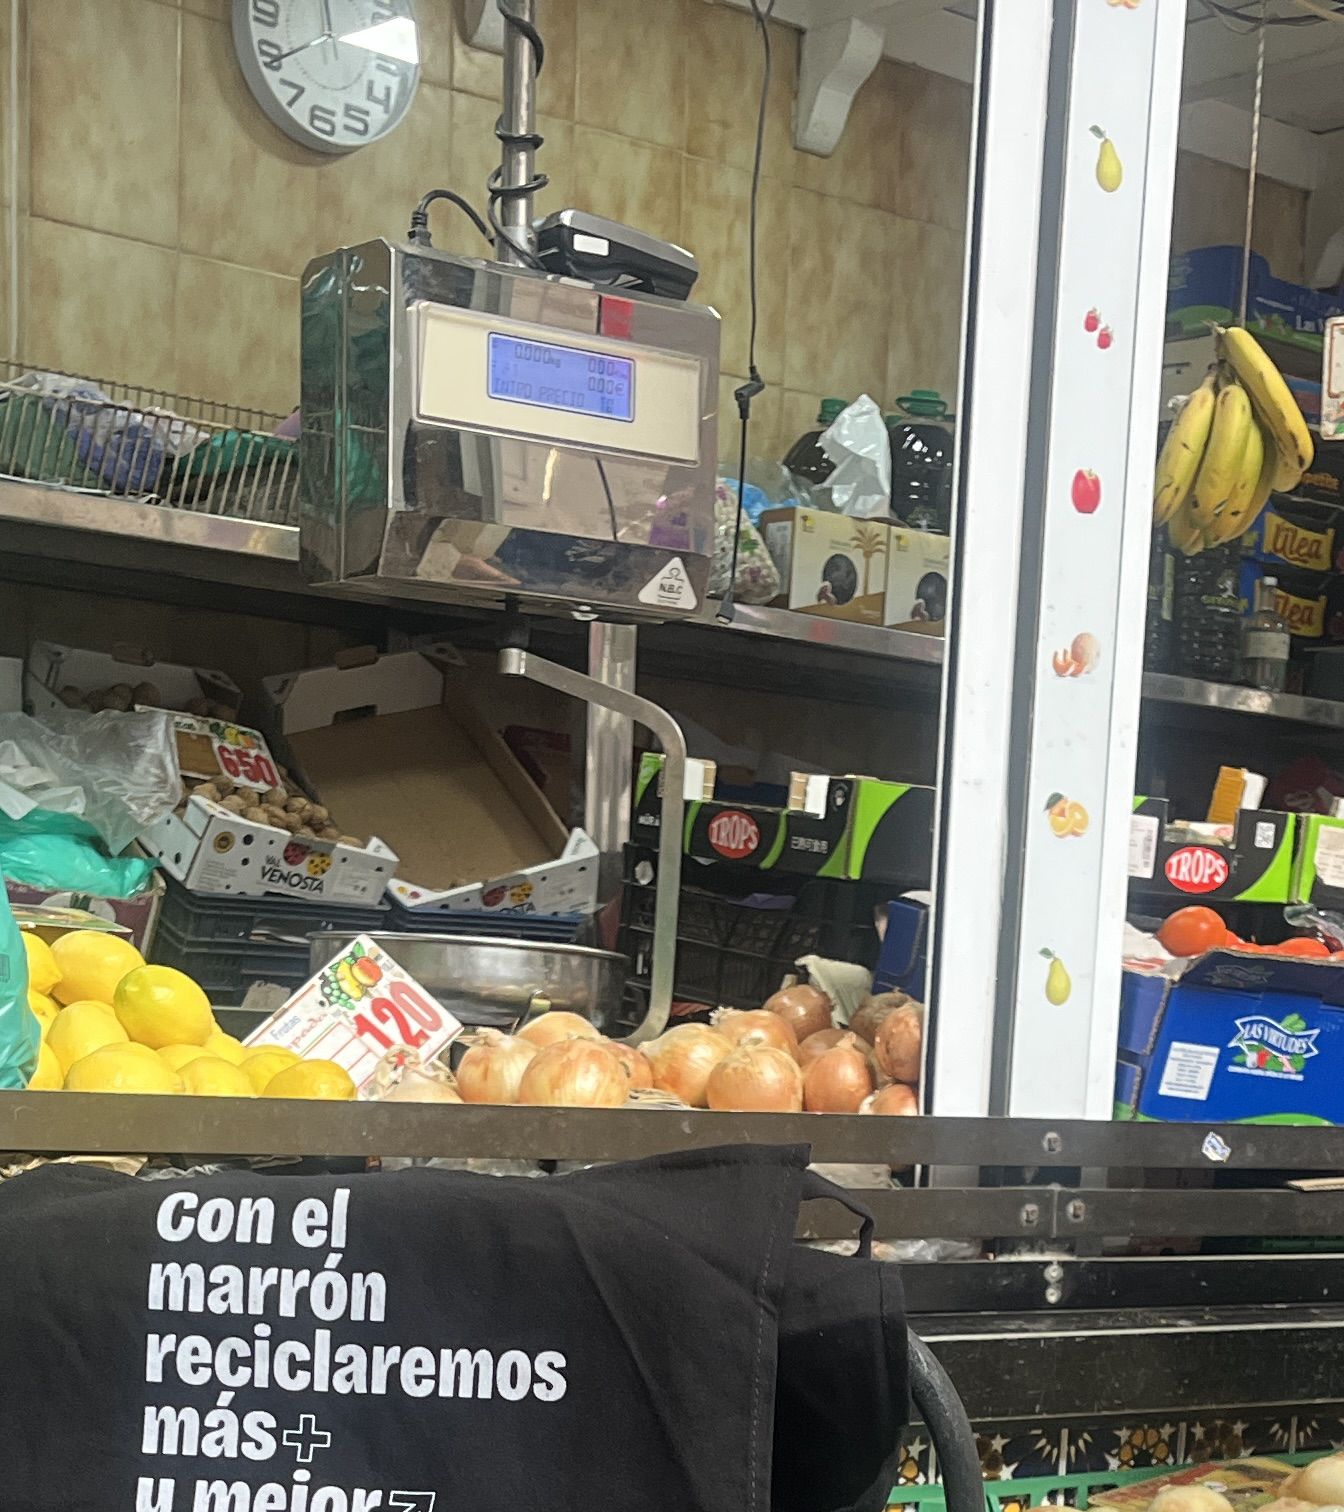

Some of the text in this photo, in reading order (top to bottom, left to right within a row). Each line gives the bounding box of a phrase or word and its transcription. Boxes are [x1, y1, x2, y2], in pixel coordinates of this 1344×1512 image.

[279, 77, 306, 109] 7
[367, 79, 392, 115] 4
[309, 104, 337, 138] 6
[343, 103, 370, 137] 5
[709, 815, 759, 851] TROPS
[260, 865, 326, 894] VENOSTA
[1166, 850, 1227, 885] TROPS
[352, 980, 443, 1051] 120
[1242, 1022, 1308, 1055] LAS VIRTUDES
[156, 1187, 351, 1249] Con el
[147, 1252, 387, 1323] marrón
[144, 1322, 568, 1402] reciclaremos
